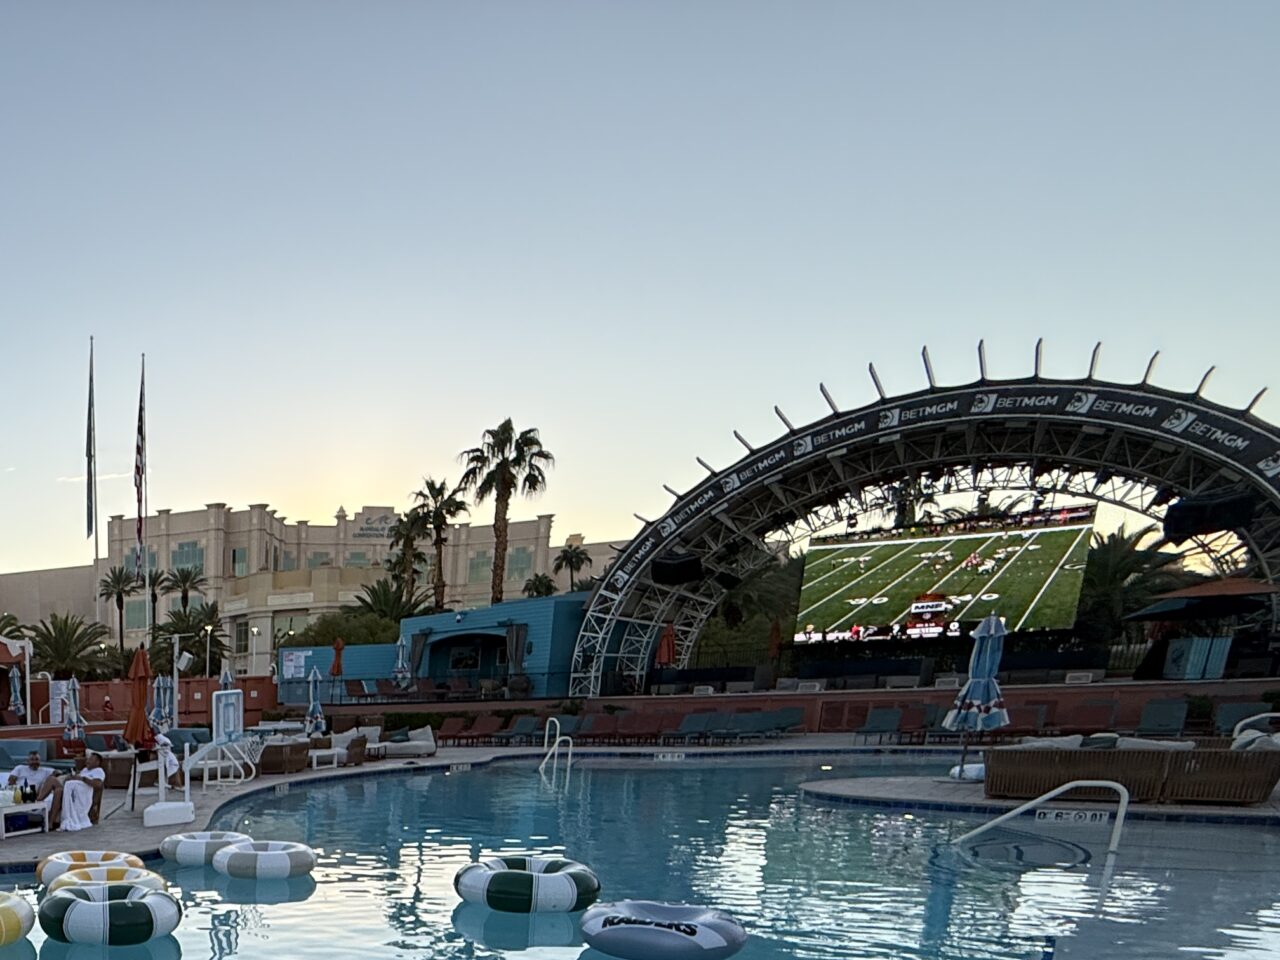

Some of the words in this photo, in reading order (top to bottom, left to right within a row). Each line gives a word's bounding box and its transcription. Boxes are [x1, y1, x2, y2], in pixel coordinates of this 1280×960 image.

[901, 401, 958, 421] BETMGM
[996, 395, 1058, 408] BETMGM
[1092, 399, 1158, 418] BETMGM
[813, 421, 865, 446] BETMGM
[1188, 421, 1251, 450] BETMGM
[739, 450, 786, 481] BETMGM
[673, 490, 714, 524] BETMGM
[623, 537, 655, 572] BETMGM
